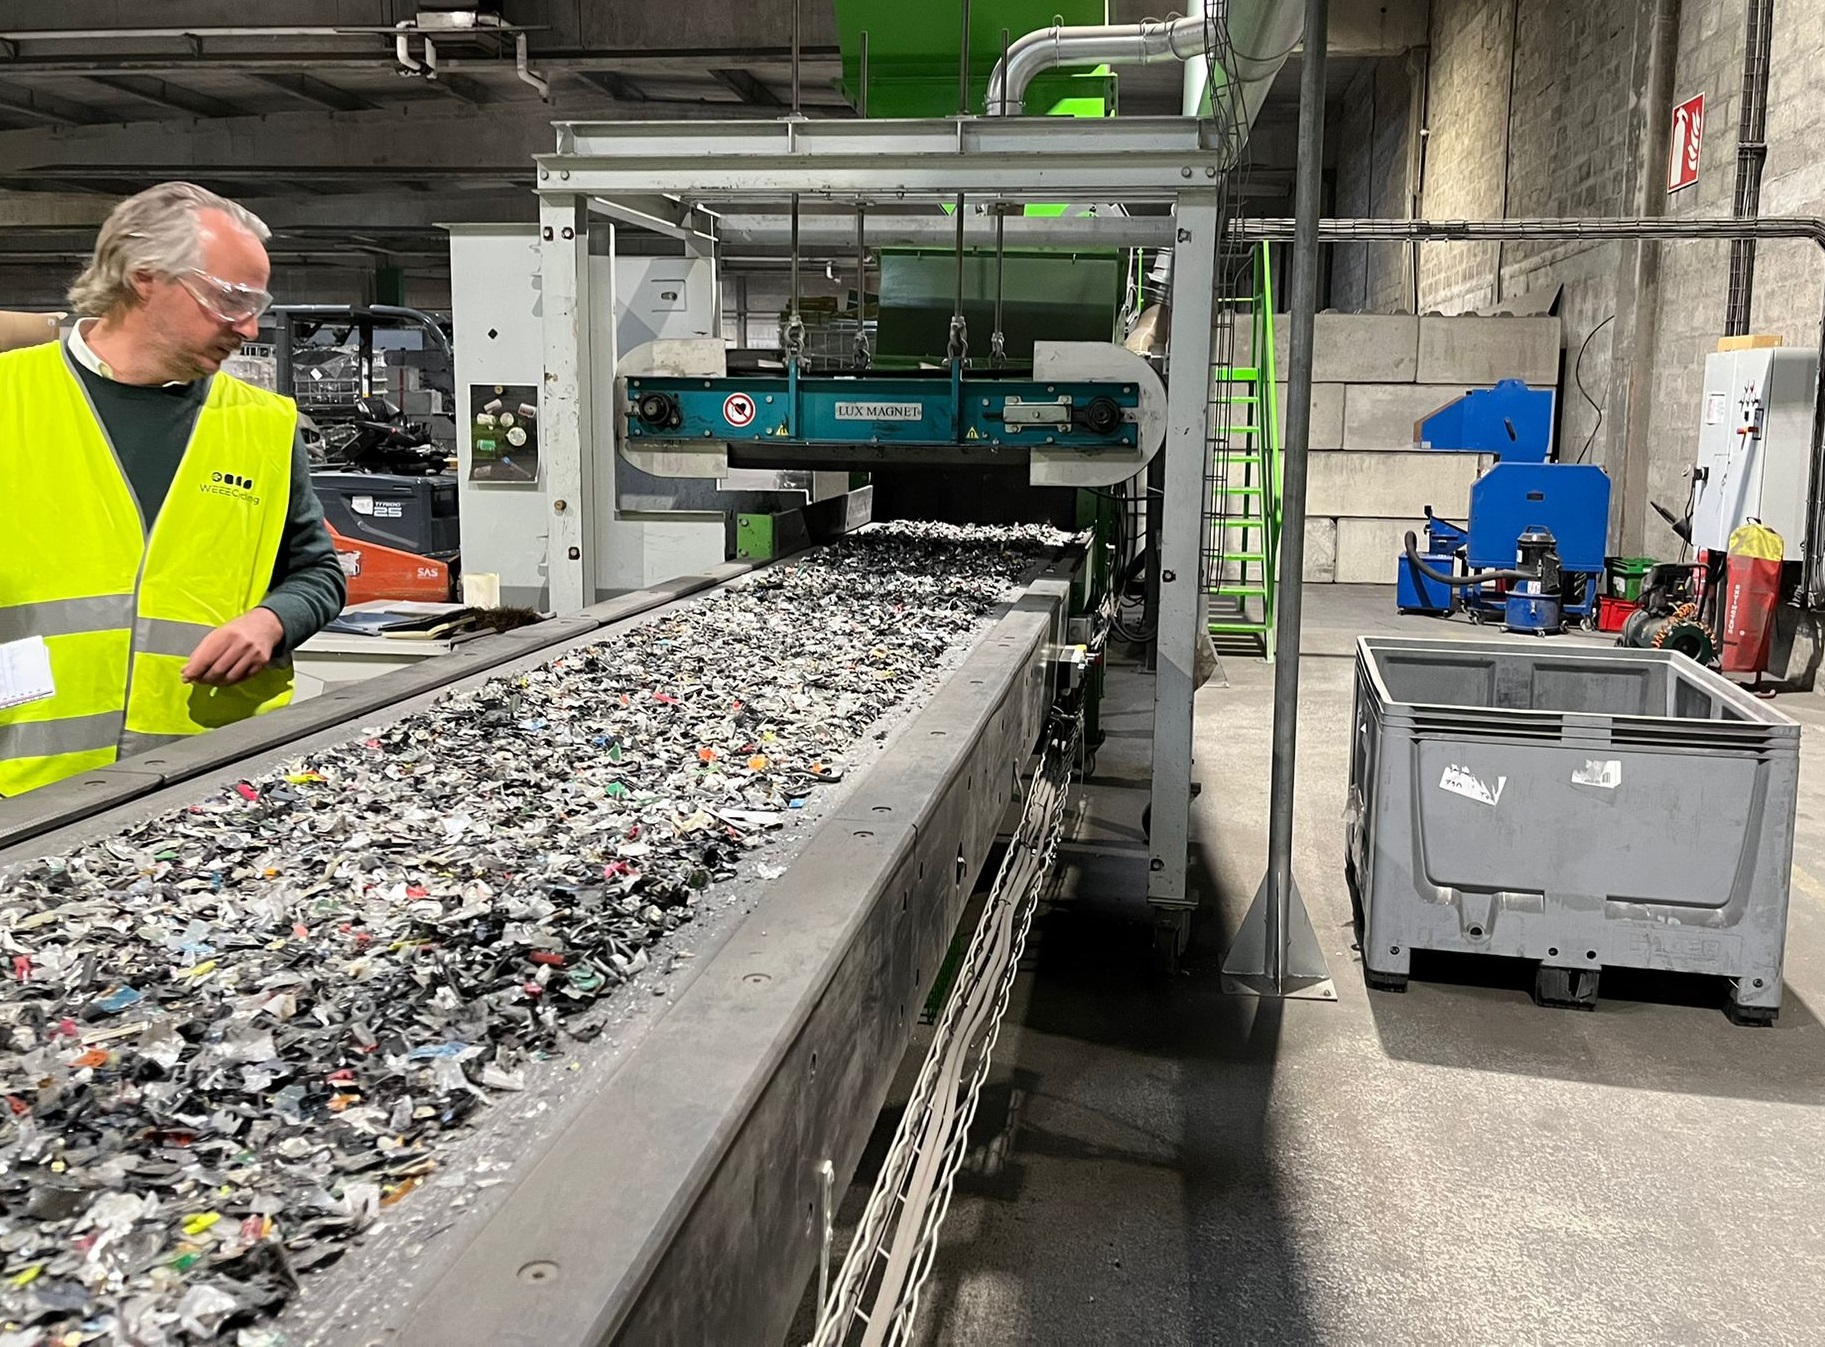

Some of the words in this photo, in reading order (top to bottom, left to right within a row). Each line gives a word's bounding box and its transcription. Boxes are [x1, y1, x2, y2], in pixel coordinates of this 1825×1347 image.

[838, 405, 863, 416] LUX
[866, 406, 919, 417] MAGNET
[373, 506, 403, 517] 25
[417, 567, 439, 579] SAS
